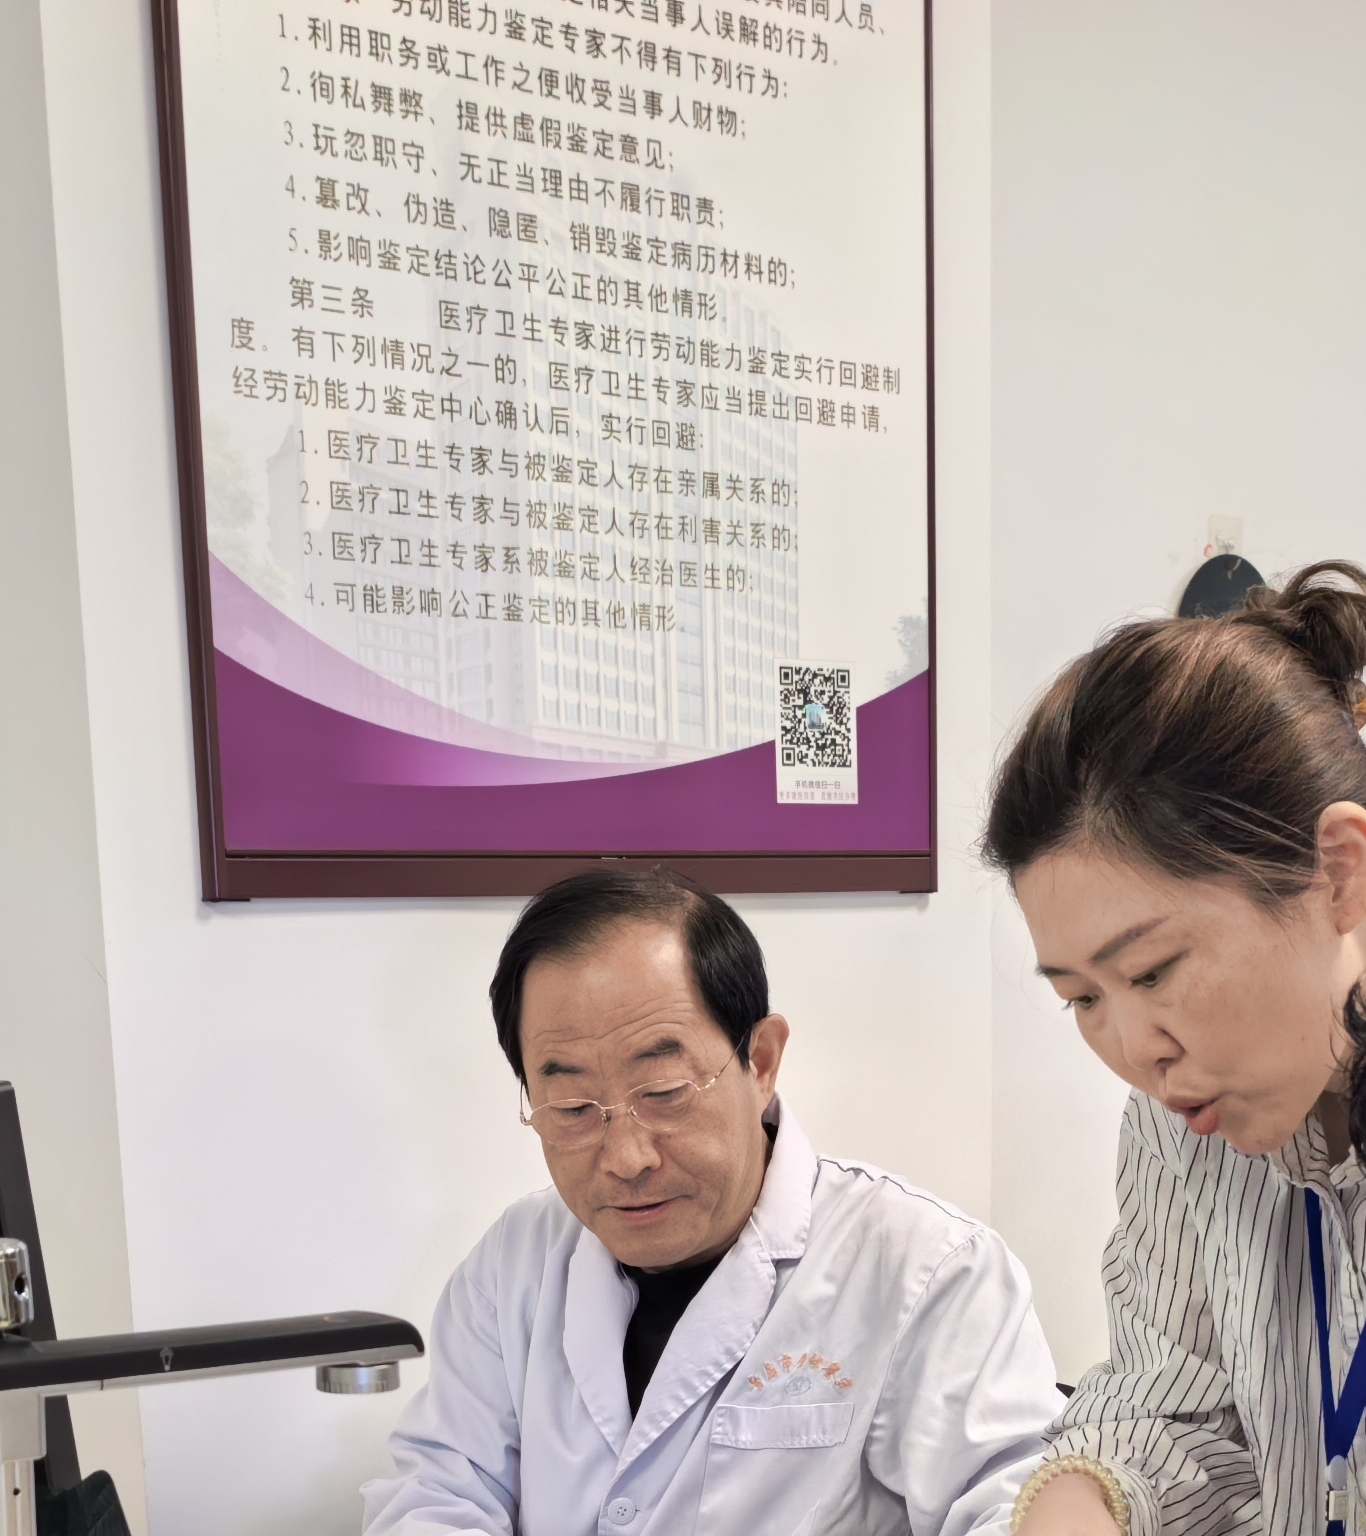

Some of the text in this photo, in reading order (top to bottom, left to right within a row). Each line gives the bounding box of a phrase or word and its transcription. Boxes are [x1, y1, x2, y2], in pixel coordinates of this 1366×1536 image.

[289, 276, 901, 394] 第三条 医疗卫生专家进行劳动能力鉴定实行回避制
